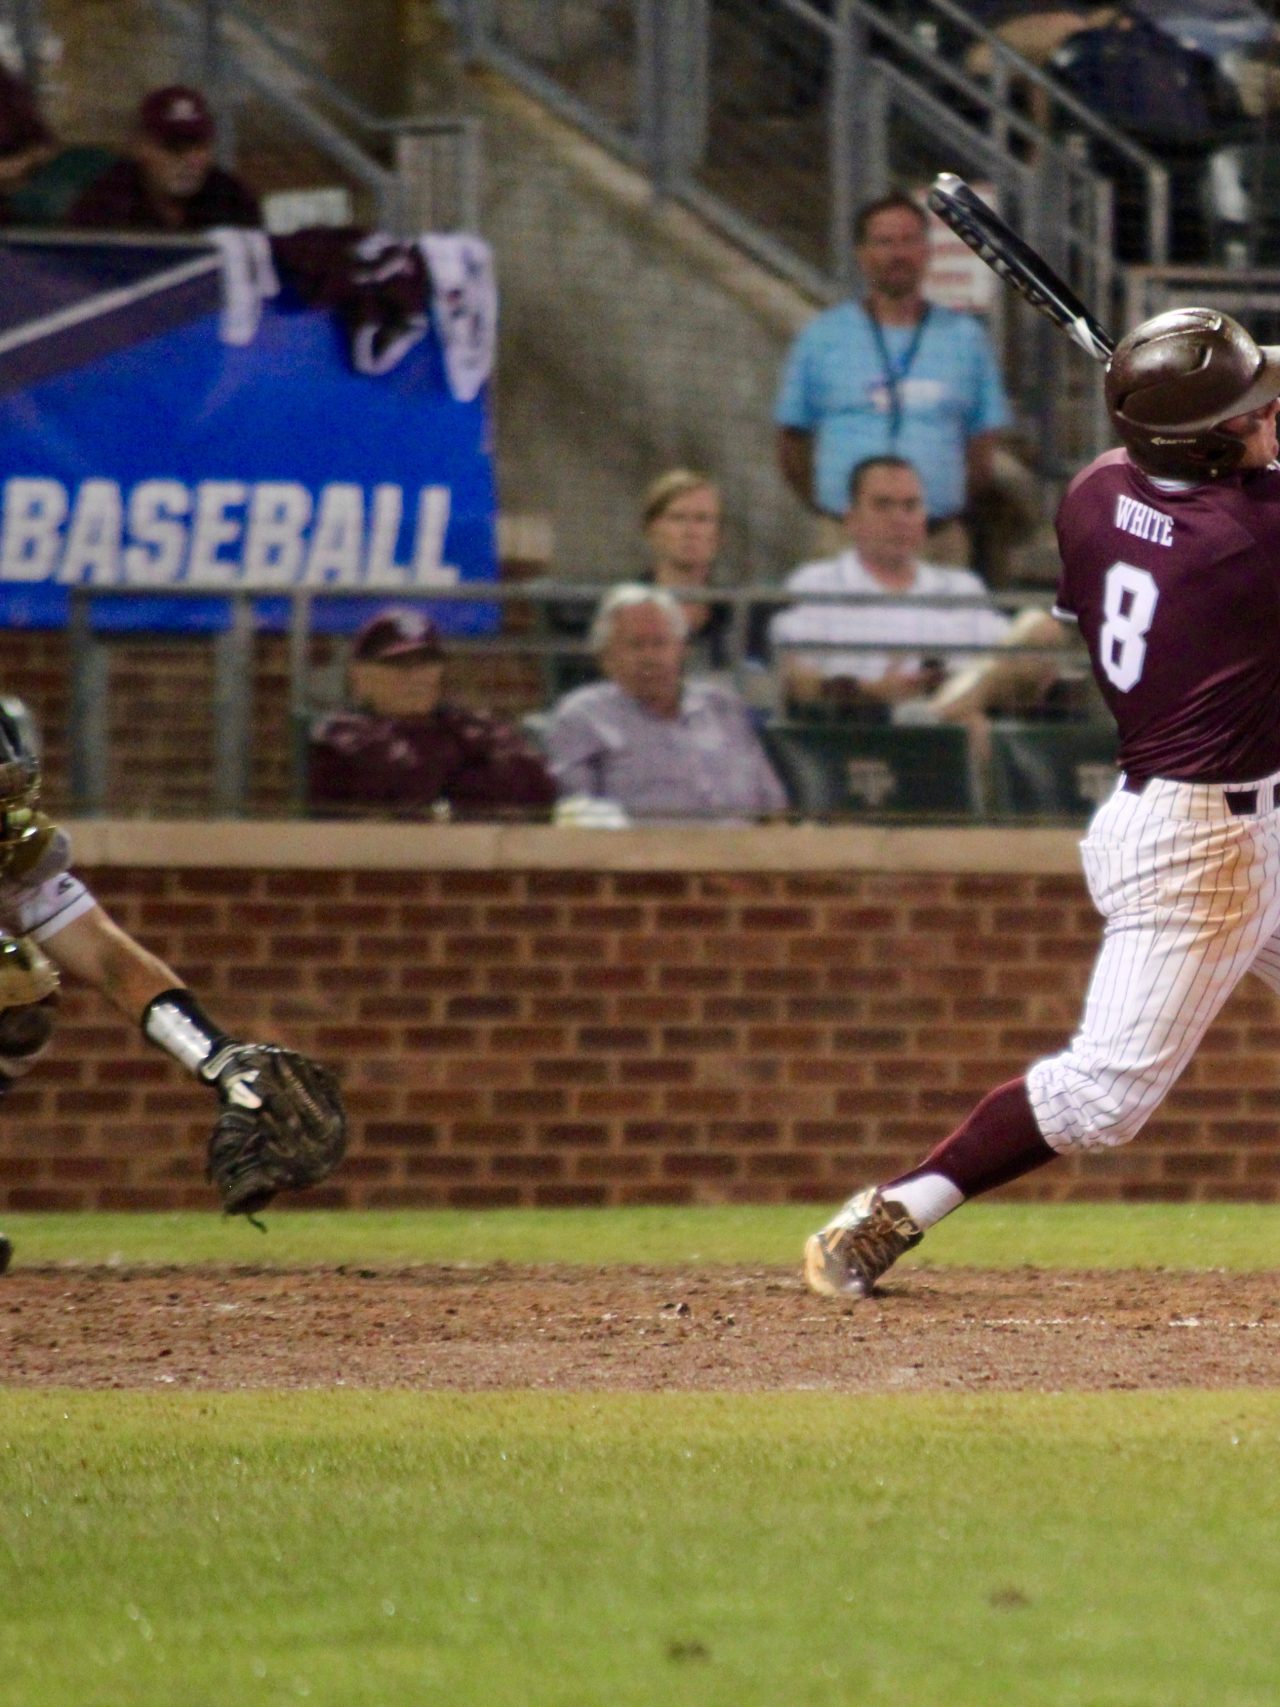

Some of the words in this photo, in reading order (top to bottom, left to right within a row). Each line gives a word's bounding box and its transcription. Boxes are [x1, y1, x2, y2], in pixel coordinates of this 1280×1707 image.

[0, 477, 461, 586] BASEBALL
[1115, 494, 1174, 548] WHITE
[1101, 560, 1160, 694] 8
